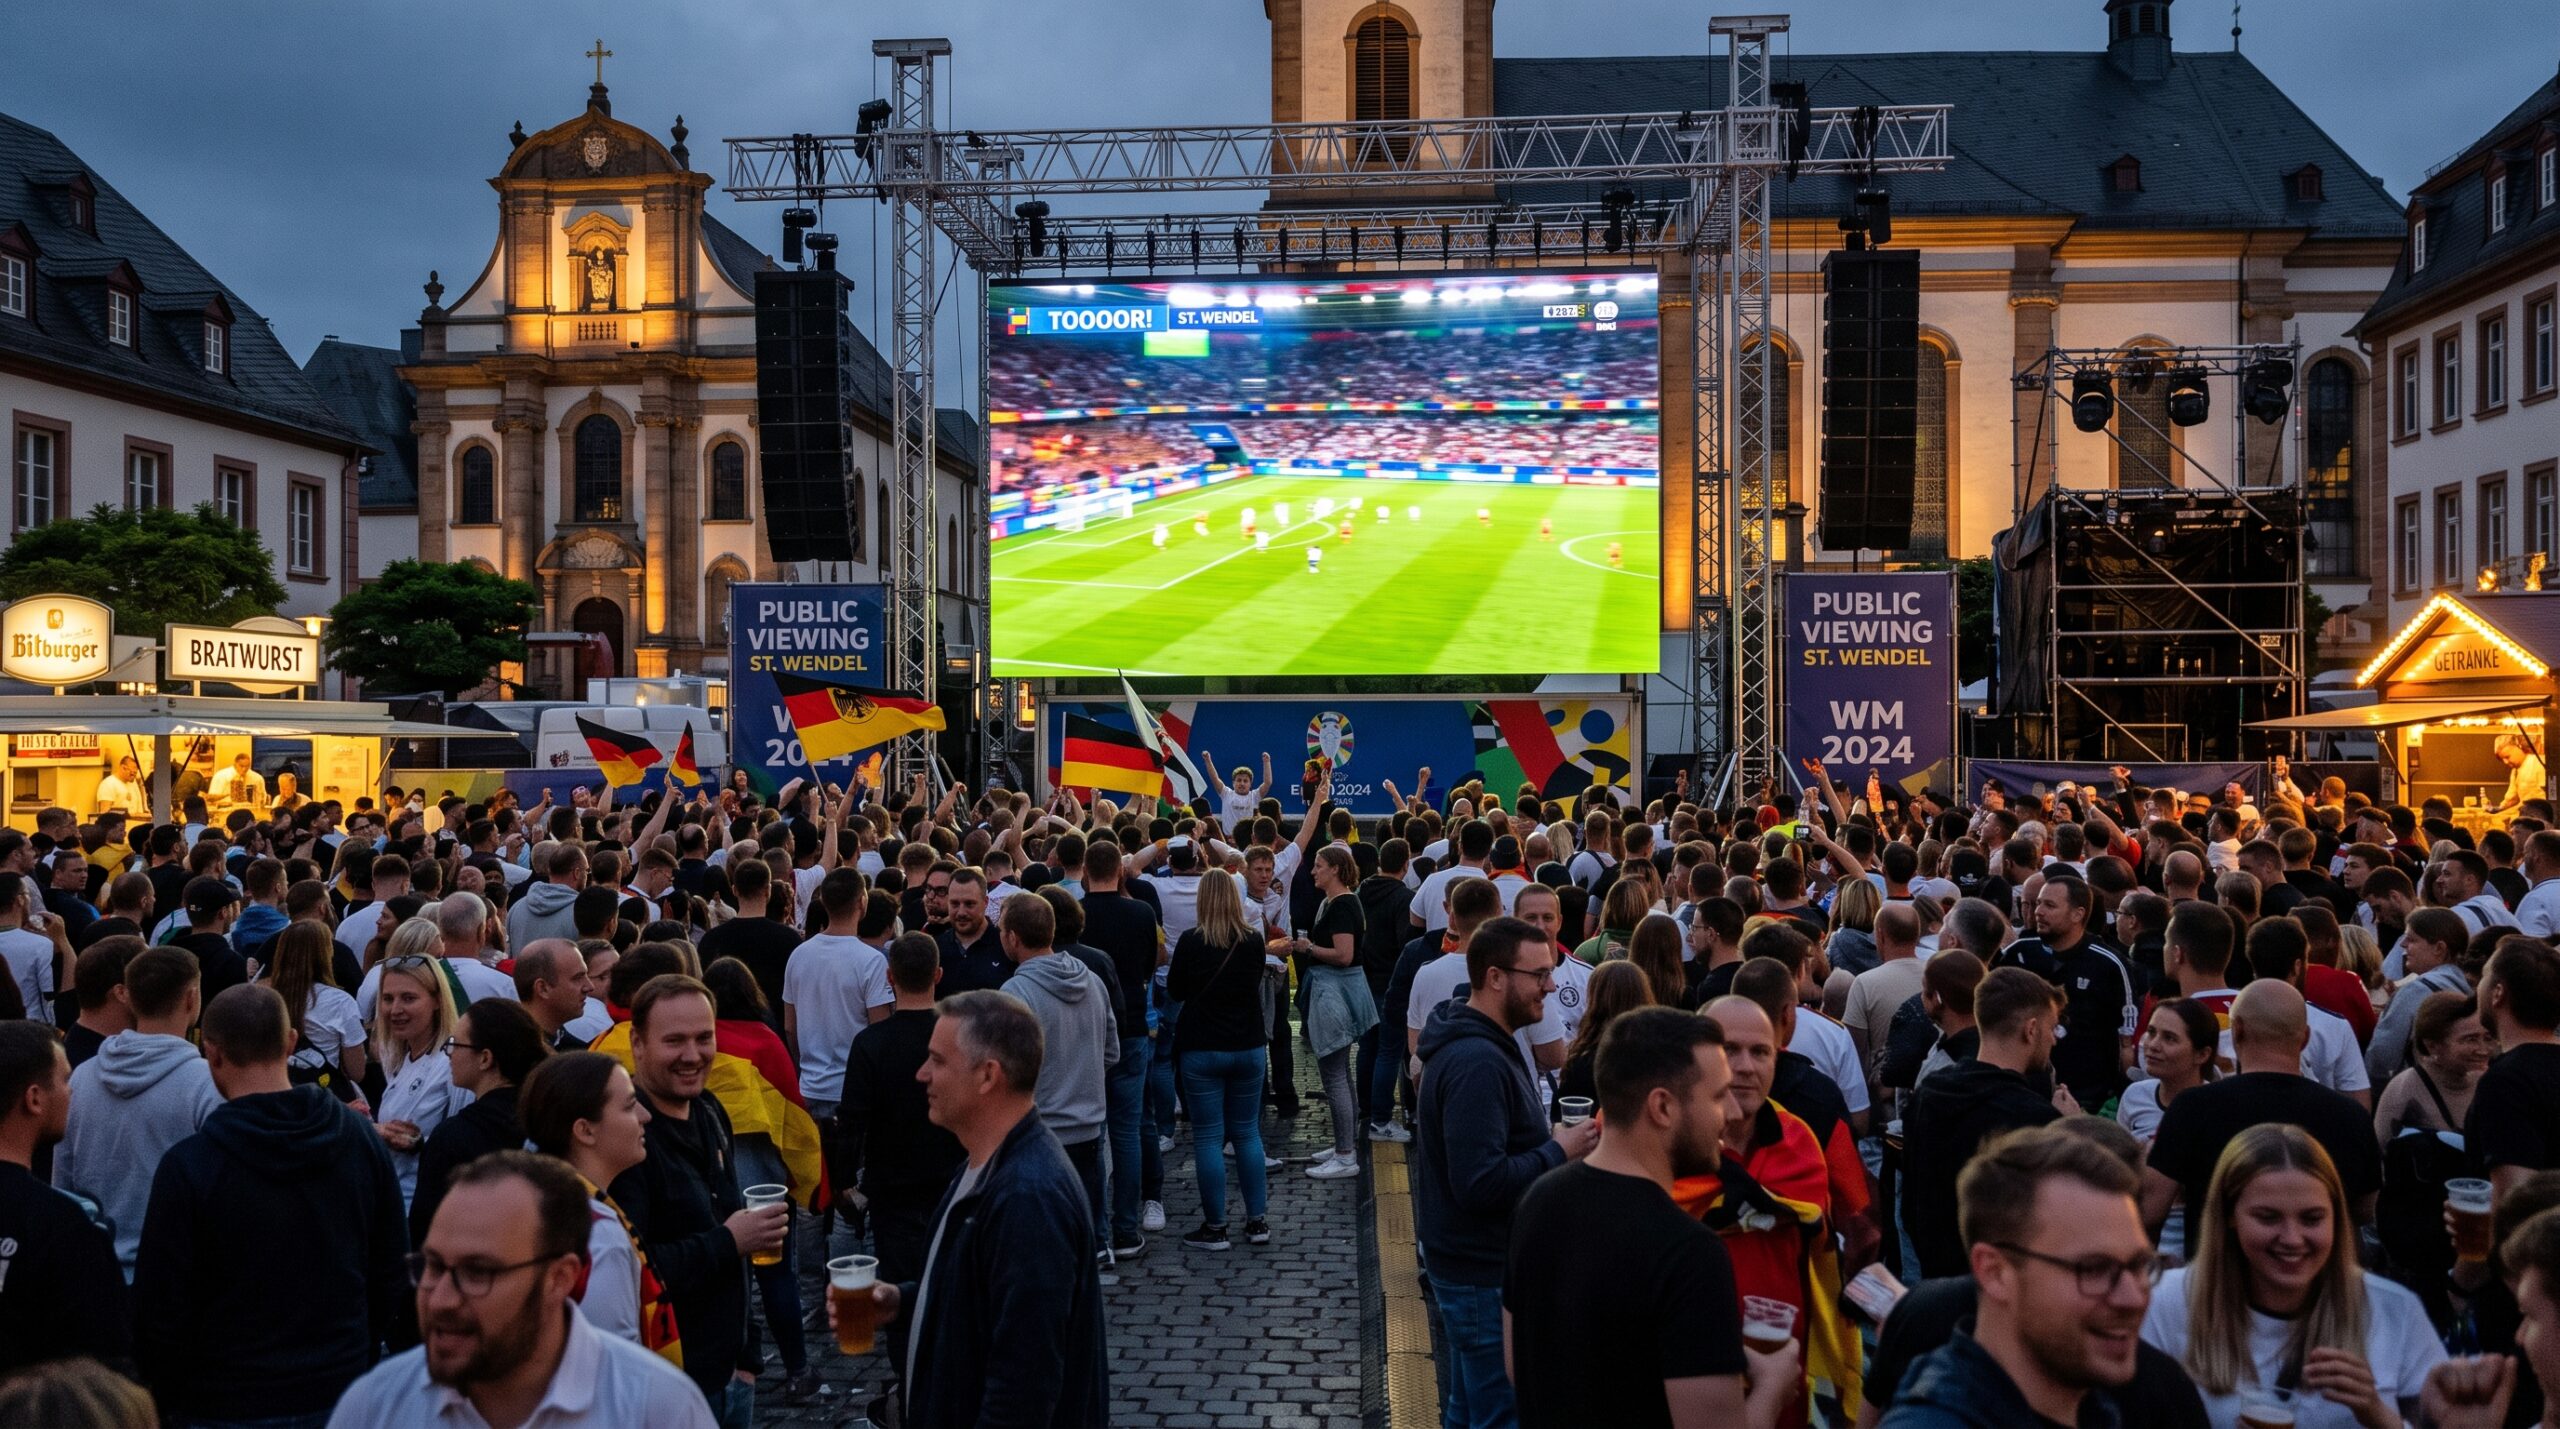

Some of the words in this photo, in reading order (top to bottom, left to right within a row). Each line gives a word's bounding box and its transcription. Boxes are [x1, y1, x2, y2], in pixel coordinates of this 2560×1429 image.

[1047, 309, 1152, 330] TOOOOR!
[1177, 311, 1199, 325] ST.
[1201, 310, 1259, 325] WENDEL
[759, 600, 859, 623] PUBLIC
[1813, 591, 1921, 616] PUBLIC
[747, 628, 869, 650] VIEWING
[1801, 620, 1933, 644] VIEWING
[11, 633, 98, 662] Bitburger
[191, 639, 303, 672] BRATWURST
[1803, 649, 1834, 666] ST.
[1839, 649, 1932, 666] WENDEL
[2434, 641, 2500, 672] GETRÄNKE
[750, 655, 777, 672] ST.
[782, 655, 868, 671] WENDEL
[1829, 700, 1904, 730] WM
[1821, 735, 1915, 765] 2024
[1336, 783, 1371, 796] 2024
